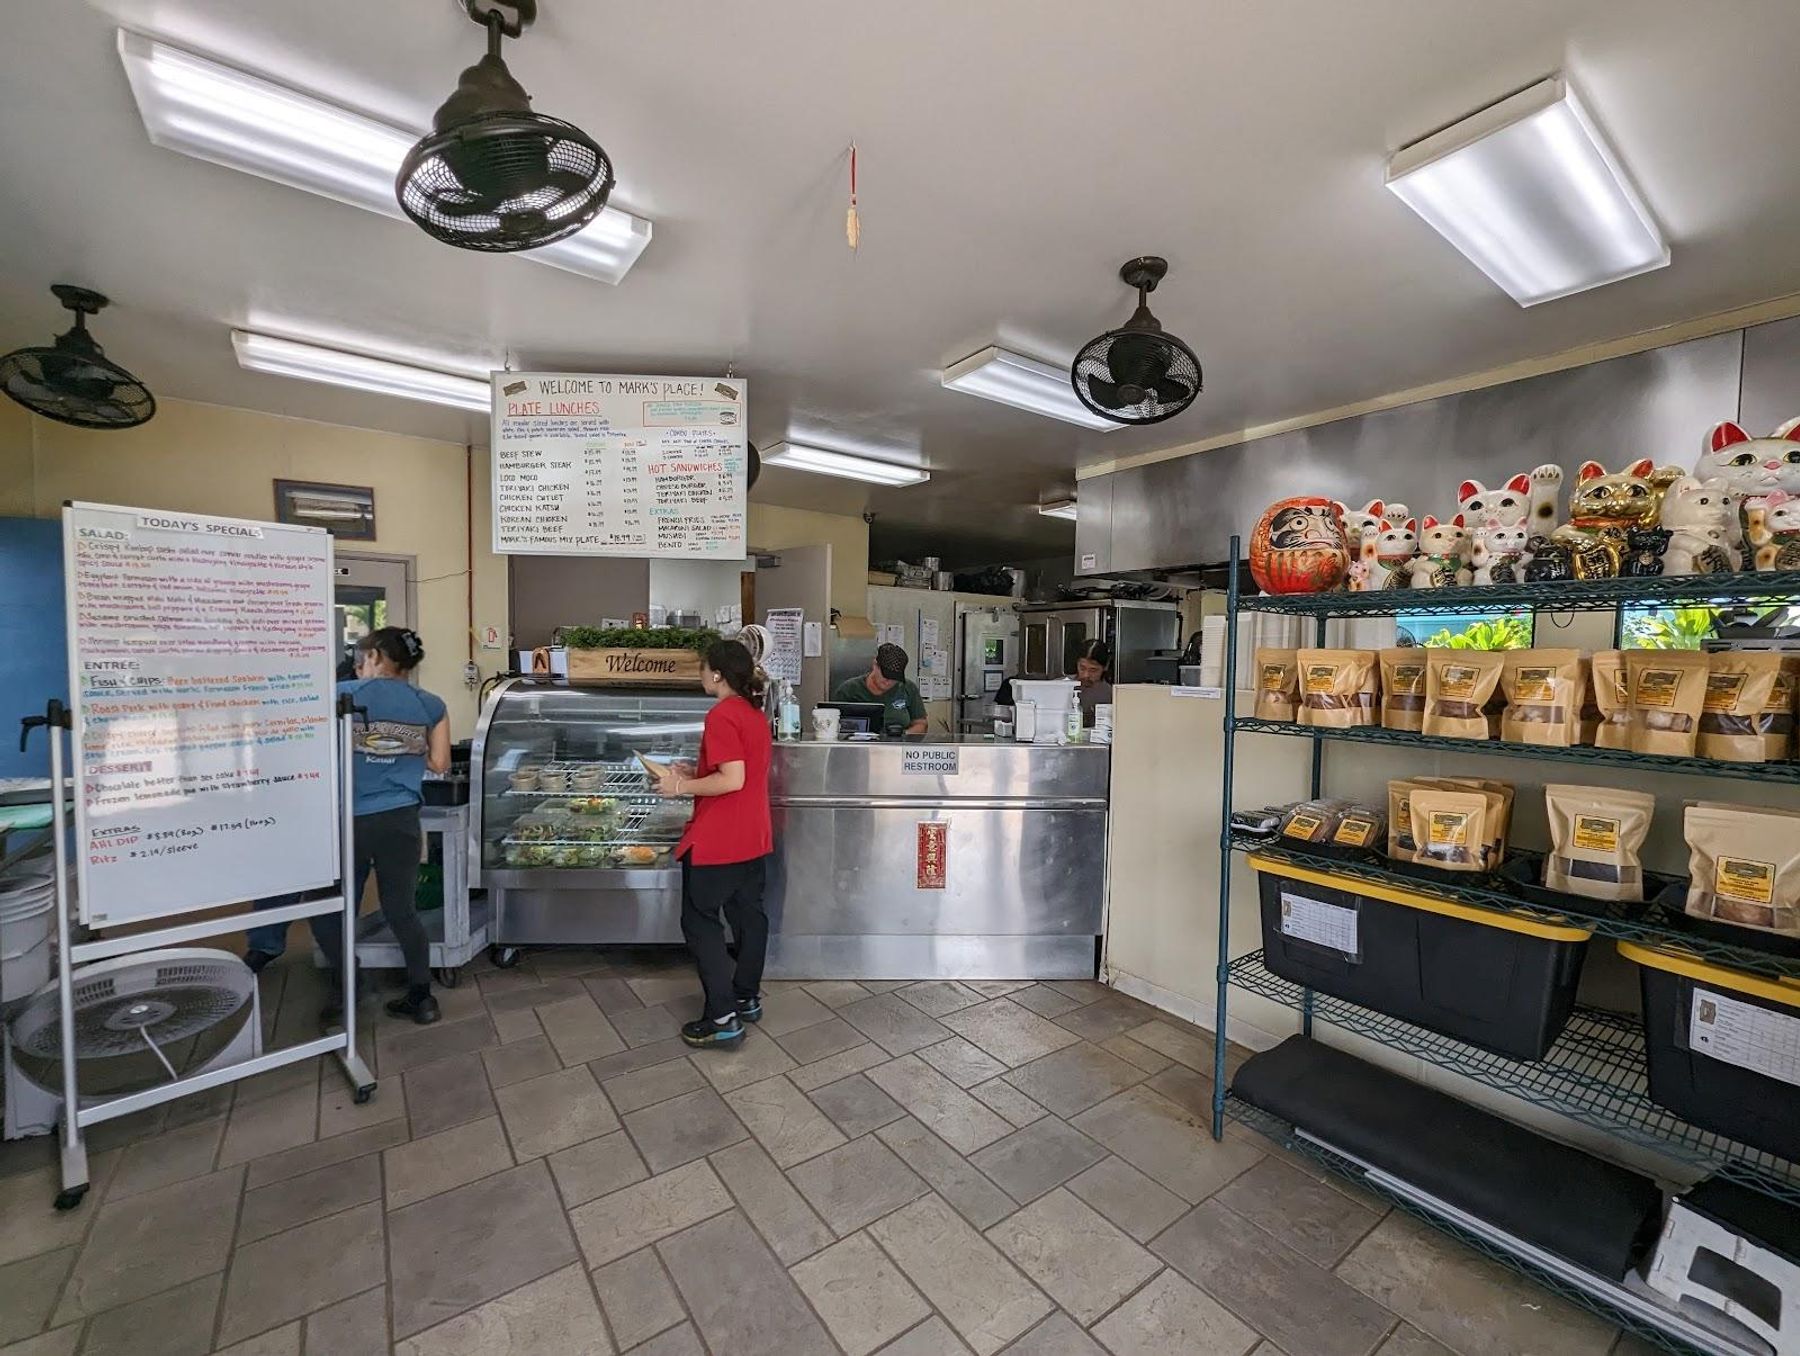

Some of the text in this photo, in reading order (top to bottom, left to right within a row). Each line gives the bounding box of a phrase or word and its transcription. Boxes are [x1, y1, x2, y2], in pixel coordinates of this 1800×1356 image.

[540, 380, 704, 401] WELCOME TO MARK'S PLACE!
[508, 402, 600, 415] PLATE LUNCHES
[500, 451, 519, 460] BEEF
[500, 462, 547, 470] HAMBURGER
[648, 464, 667, 474] HOT
[670, 463, 723, 472] SANDWICHES
[538, 483, 570, 491] CHICKEN
[536, 493, 564, 501] CUTLET
[649, 507, 680, 516] EXTRAS
[142, 516, 199, 532] TODAY'S
[500, 515, 568, 524] KOREAN CHICKEN
[79, 528, 129, 540] SALAD:
[542, 525, 563, 533] BEEF
[575, 535, 600, 546] PLATE
[89, 542, 120, 553] Crispy
[605, 652, 677, 673] Welcome
[905, 750, 956, 760] NO PUBLIC
[904, 762, 957, 771] RESTROOM
[90, 839, 113, 851] AHI
[117, 836, 139, 847] DIP
